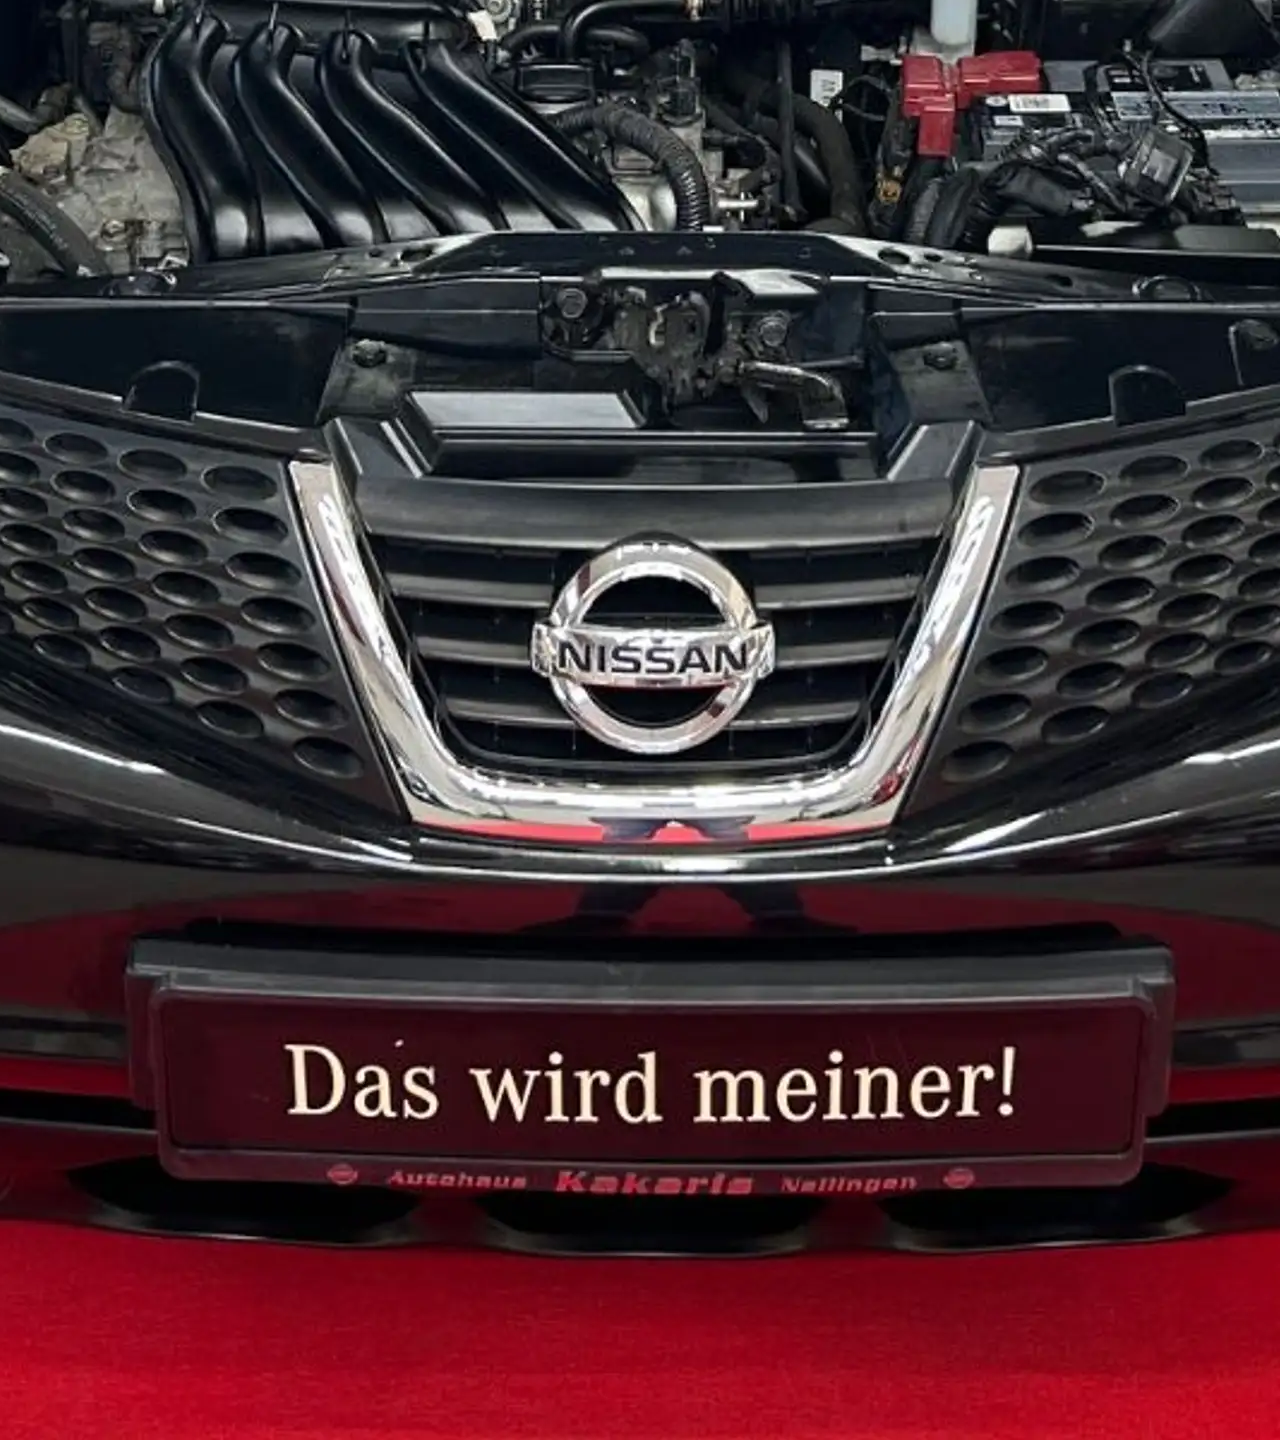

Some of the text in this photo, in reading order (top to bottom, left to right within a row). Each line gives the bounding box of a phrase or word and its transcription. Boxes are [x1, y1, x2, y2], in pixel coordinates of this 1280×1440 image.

[558, 642, 748, 674] NISSAN
[285, 1043, 1017, 1124] Das wird meiner!
[388, 1168, 527, 1190] Autohaus
